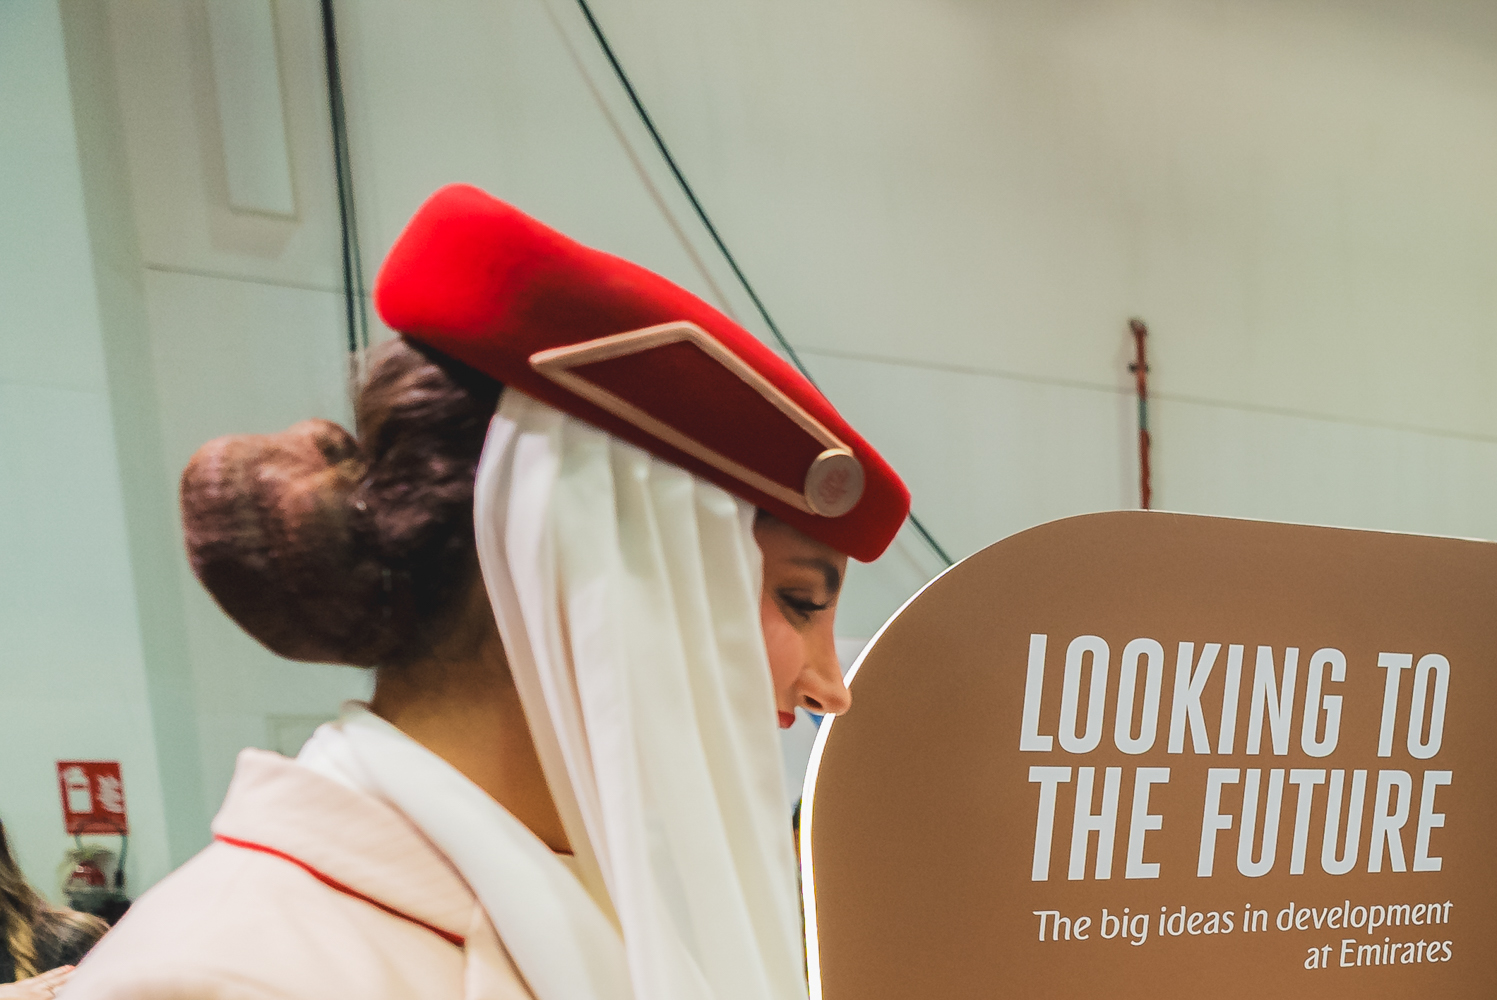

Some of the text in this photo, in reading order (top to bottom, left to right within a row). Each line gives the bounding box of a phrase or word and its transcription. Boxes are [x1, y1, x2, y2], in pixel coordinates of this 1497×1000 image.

[1019, 634, 1451, 760] LOOKING TO
[1028, 766, 1453, 881] THE FUTURE
[1033, 900, 1453, 946] The big ideas in development
[1304, 937, 1453, 969] at Emirates
